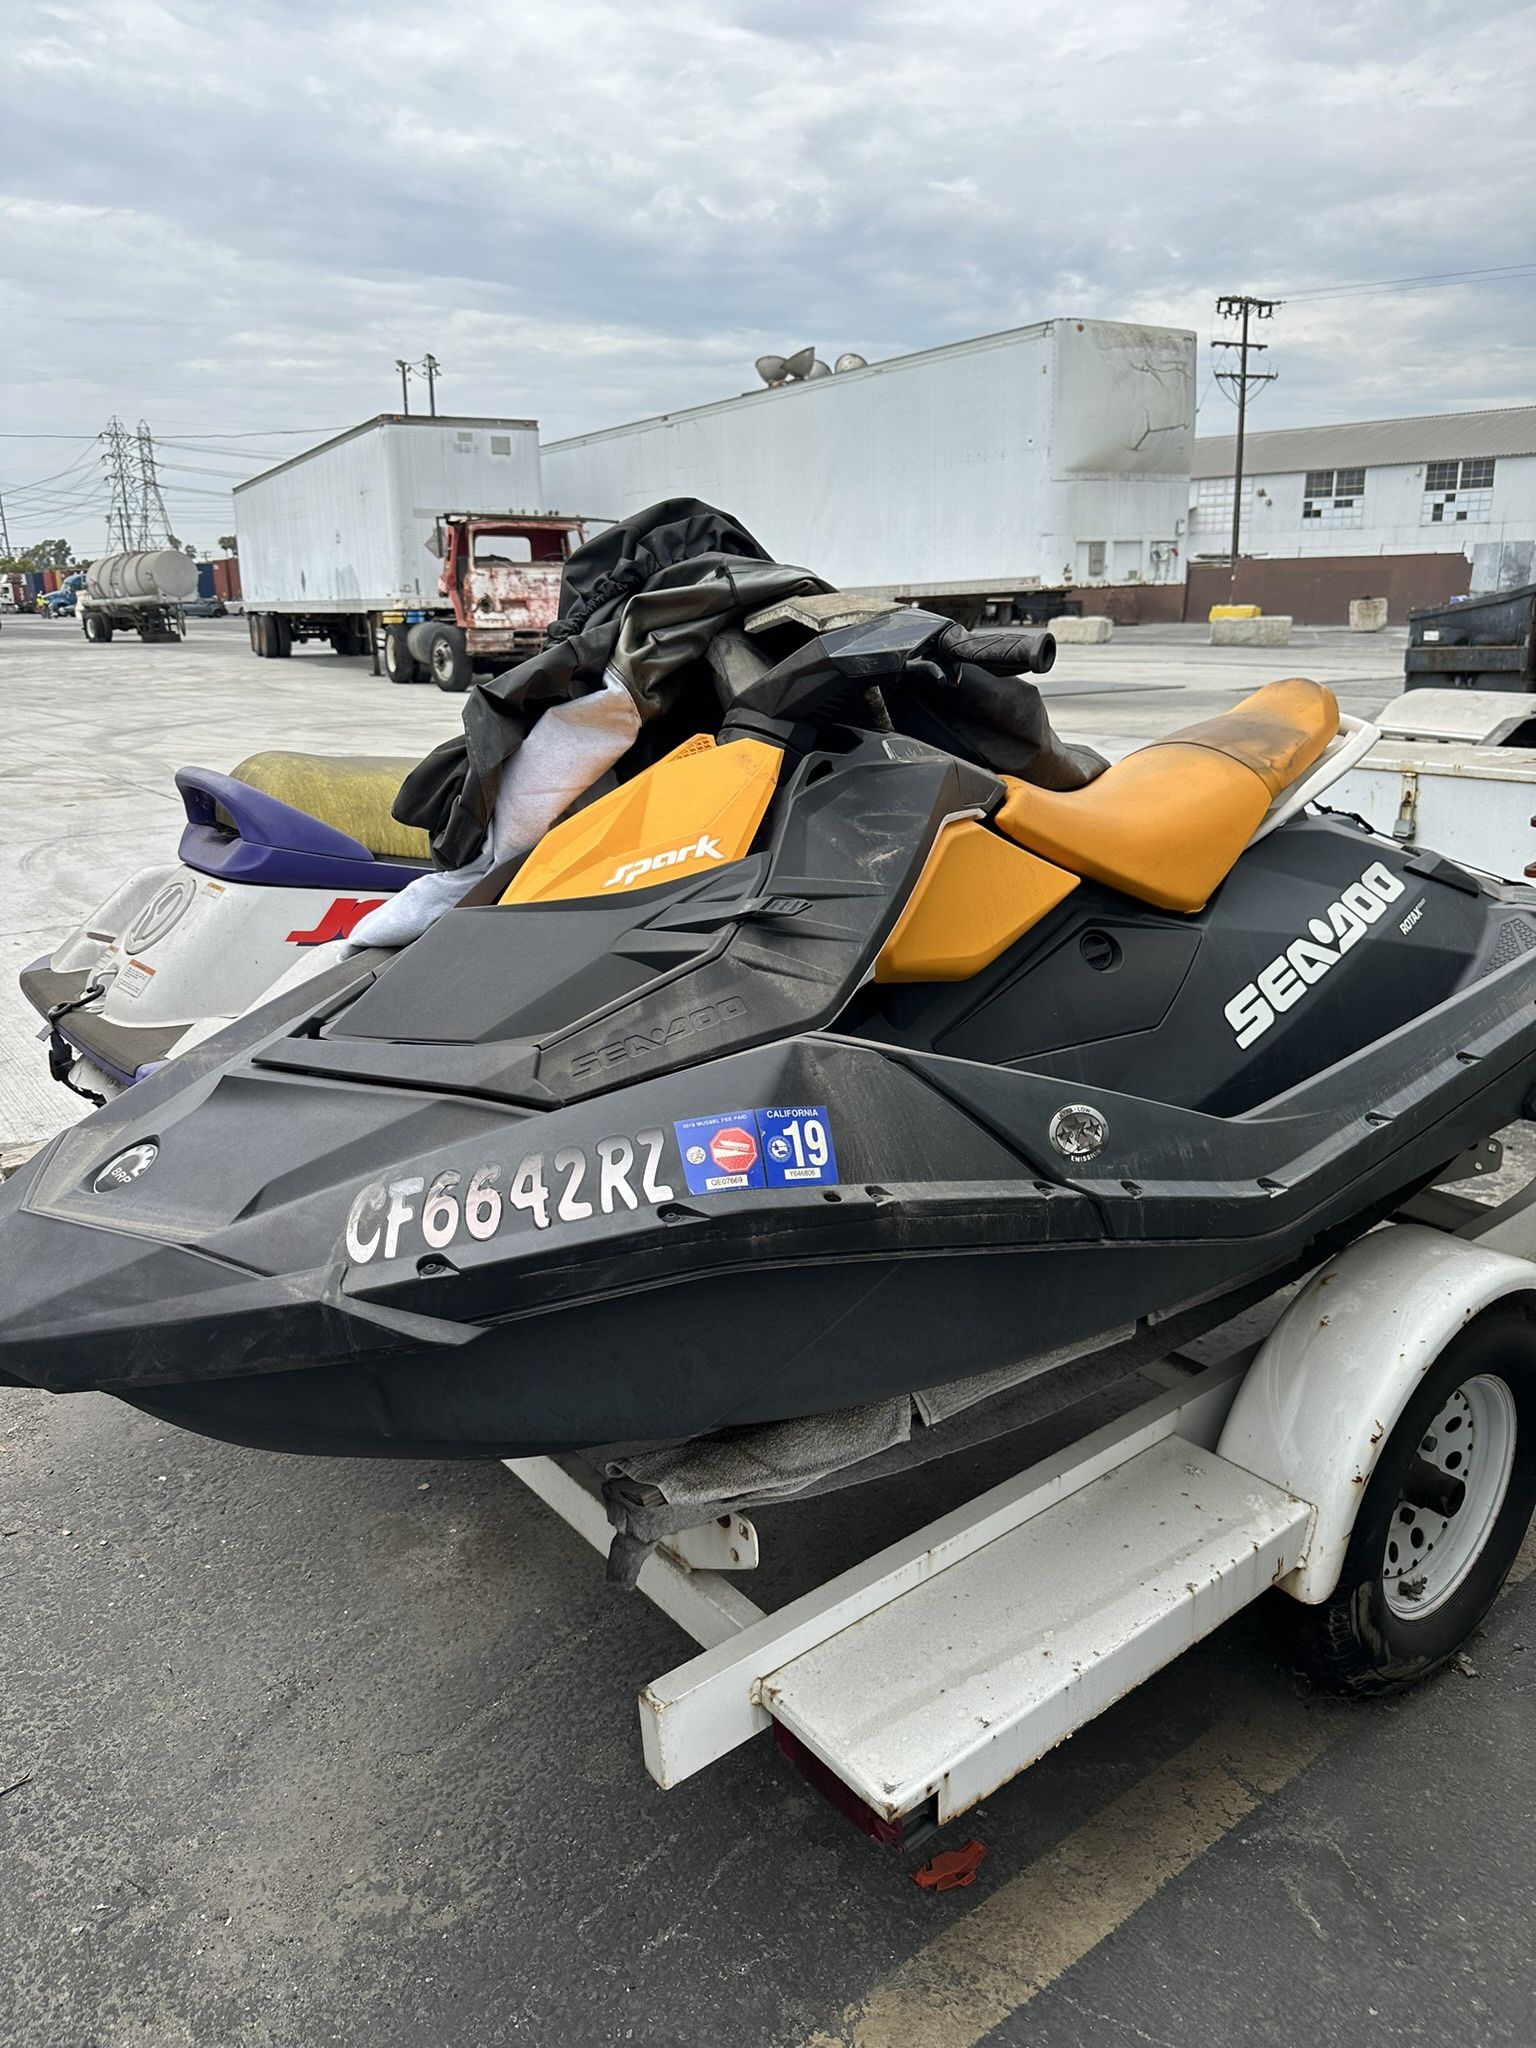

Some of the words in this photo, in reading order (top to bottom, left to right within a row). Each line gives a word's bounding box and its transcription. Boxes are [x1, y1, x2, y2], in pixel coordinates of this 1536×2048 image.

[1399, 905, 1423, 936] ROTAX
[766, 1108, 819, 1118] CALIFORNIA
[696, 1118, 720, 1127] MUSSEL
[782, 1119, 829, 1167] 19
[111, 1167, 132, 1183] BRP
